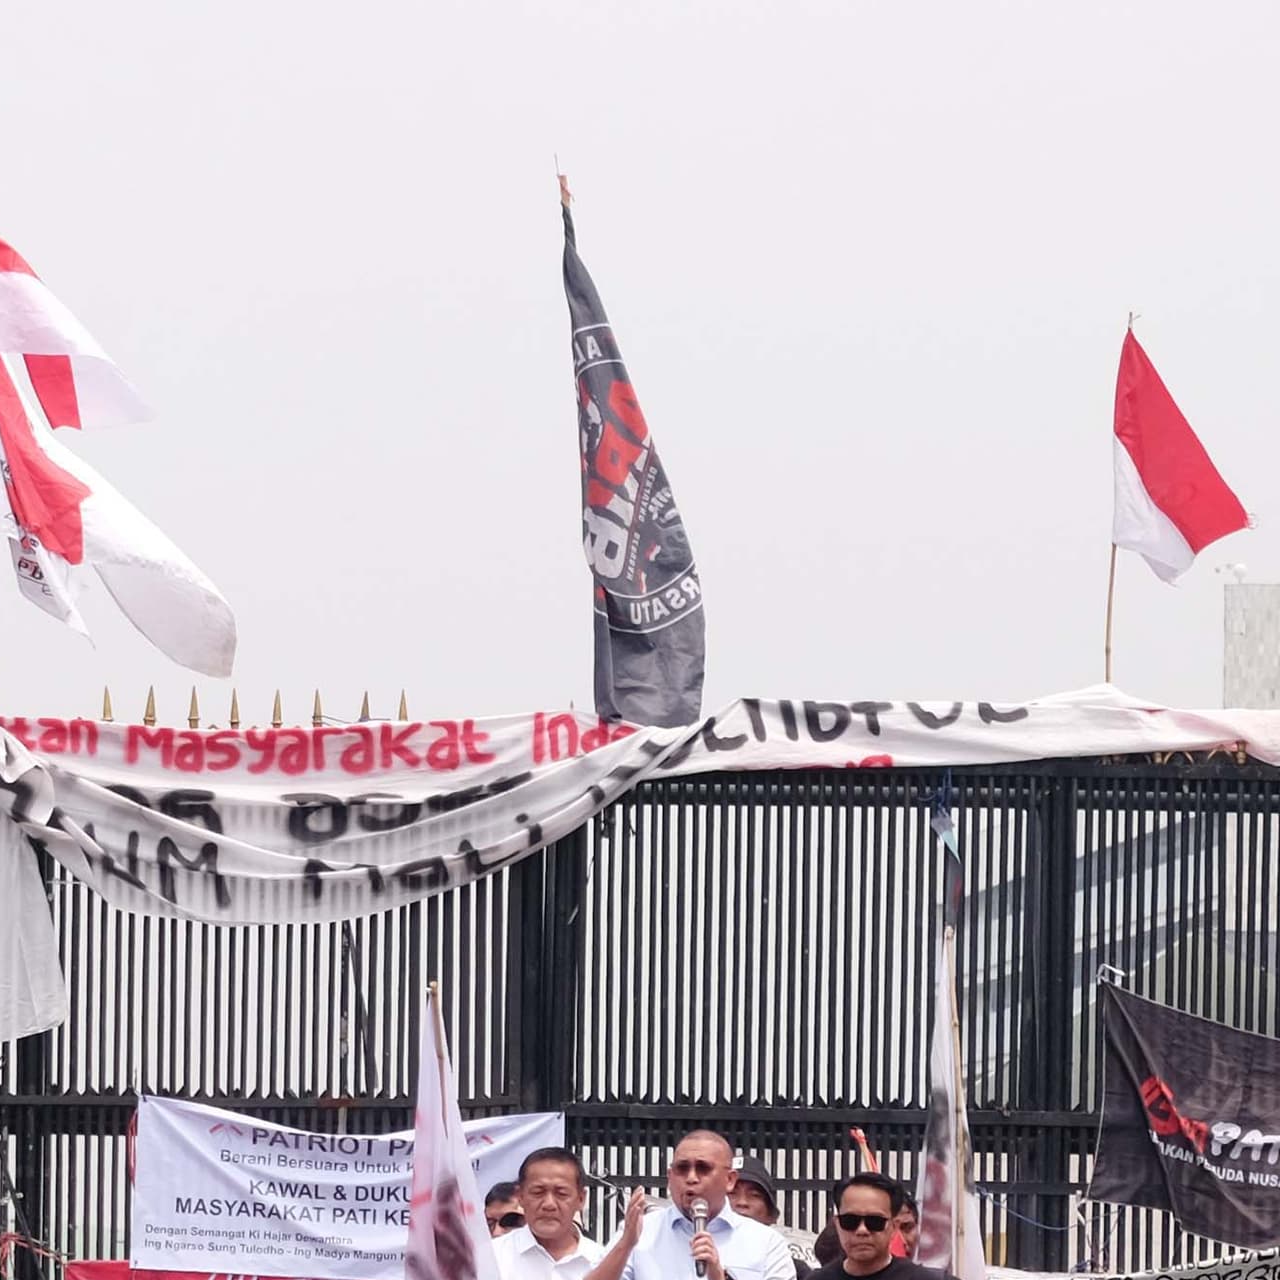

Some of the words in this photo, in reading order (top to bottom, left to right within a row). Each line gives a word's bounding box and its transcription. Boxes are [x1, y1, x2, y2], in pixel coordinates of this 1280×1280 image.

[126, 719, 496, 774] Masyarakat
[251, 1126, 379, 1157] PATRIOT
[220, 1149, 272, 1168] Berani
[277, 1154, 349, 1174] Bersuara
[354, 1160, 401, 1175] Untuk
[249, 1179, 327, 1201] KAWAL
[333, 1184, 348, 1201] &
[175, 1197, 326, 1224] MASYARAKAT
[332, 1206, 377, 1225] PATI
[145, 1223, 188, 1239] Dengan
[190, 1226, 246, 1241] Semangat
[295, 1232, 354, 1246] Dewantara
[144, 1238, 162, 1251] Ing
[207, 1242, 237, 1256] Sung
[353, 1250, 398, 1264] Mangun
